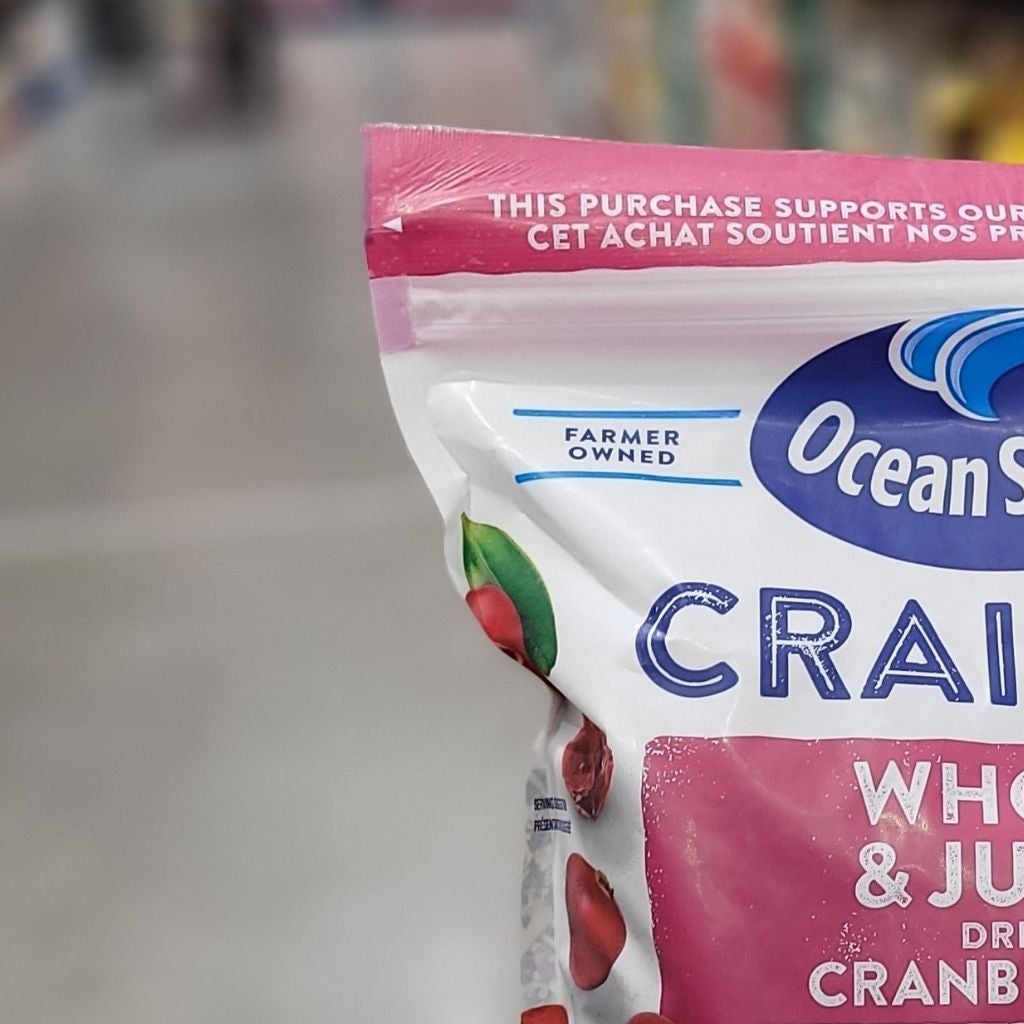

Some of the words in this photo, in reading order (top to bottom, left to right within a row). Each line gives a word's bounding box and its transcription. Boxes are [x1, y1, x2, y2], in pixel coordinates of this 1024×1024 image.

[487, 193, 567, 218] THIS
[580, 193, 762, 219] PURCHASE
[775, 197, 947, 221] SUPPORTS
[527, 223, 597, 251] CET
[601, 222, 714, 249] ACHAT
[727, 222, 895, 246] SOUTIENT
[907, 223, 978, 243] NOS
[564, 427, 681, 446] FARMER
[568, 446, 676, 466] OWNED
[787, 400, 989, 518] Ocean
[854, 841, 913, 910] &
